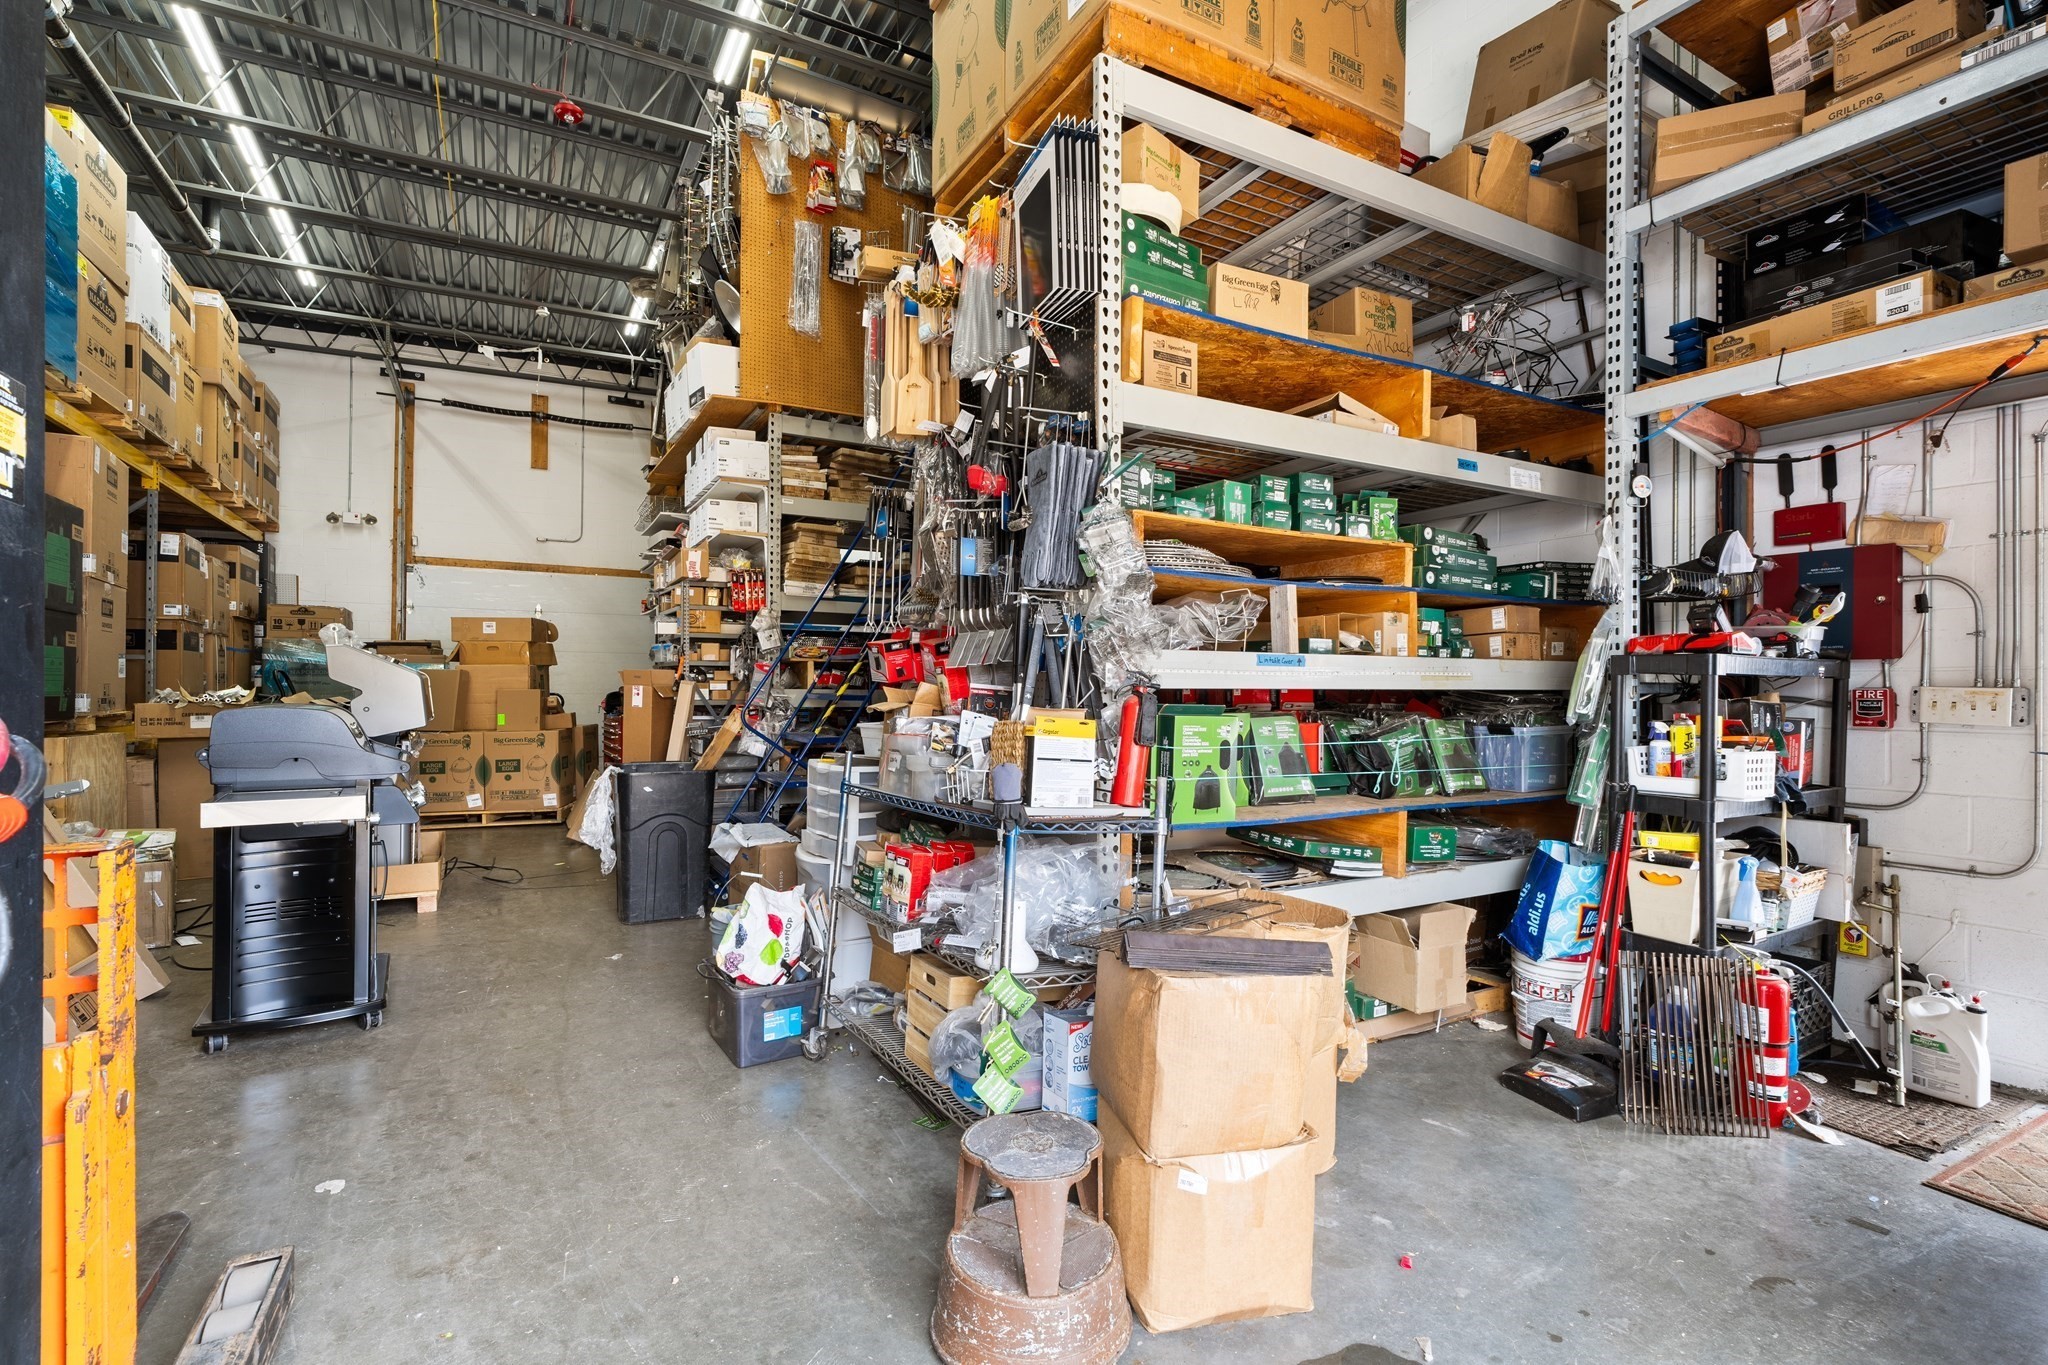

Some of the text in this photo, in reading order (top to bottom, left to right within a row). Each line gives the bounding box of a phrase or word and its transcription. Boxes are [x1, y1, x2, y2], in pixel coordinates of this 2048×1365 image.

[1036, 7, 1060, 40] FRAGILE
[1510, 42, 1544, 63] Broil King
[1332, 53, 1362, 74] FRAGILE
[1828, 92, 1884, 121] GRILLPRO
[957, 111, 975, 136] FRAGILE
[89, 182, 113, 209] PRESTIGE
[1221, 274, 1234, 285] Big
[1234, 277, 1255, 289] Green
[1256, 281, 1269, 293] Egg
[2000, 270, 2042, 287] NAPOLEON
[88, 290, 116, 325] NAPOLEON
[1365, 310, 1386, 322] Green
[1374, 304, 1386, 316] Big
[92, 314, 113, 336] PRESTIGE
[1373, 319, 1386, 331] Egg
[1855, 690, 1884, 699] FIRE
[450, 737, 462, 746] Egg
[494, 736, 536, 745] Big Green Egg
[1526, 892, 1546, 936] aldi.us
[1073, 1032, 1093, 1053] Sco
[1073, 1055, 1089, 1065] CLE
[1073, 1064, 1089, 1072] TOW
[1072, 1106, 1082, 1115] 2X
